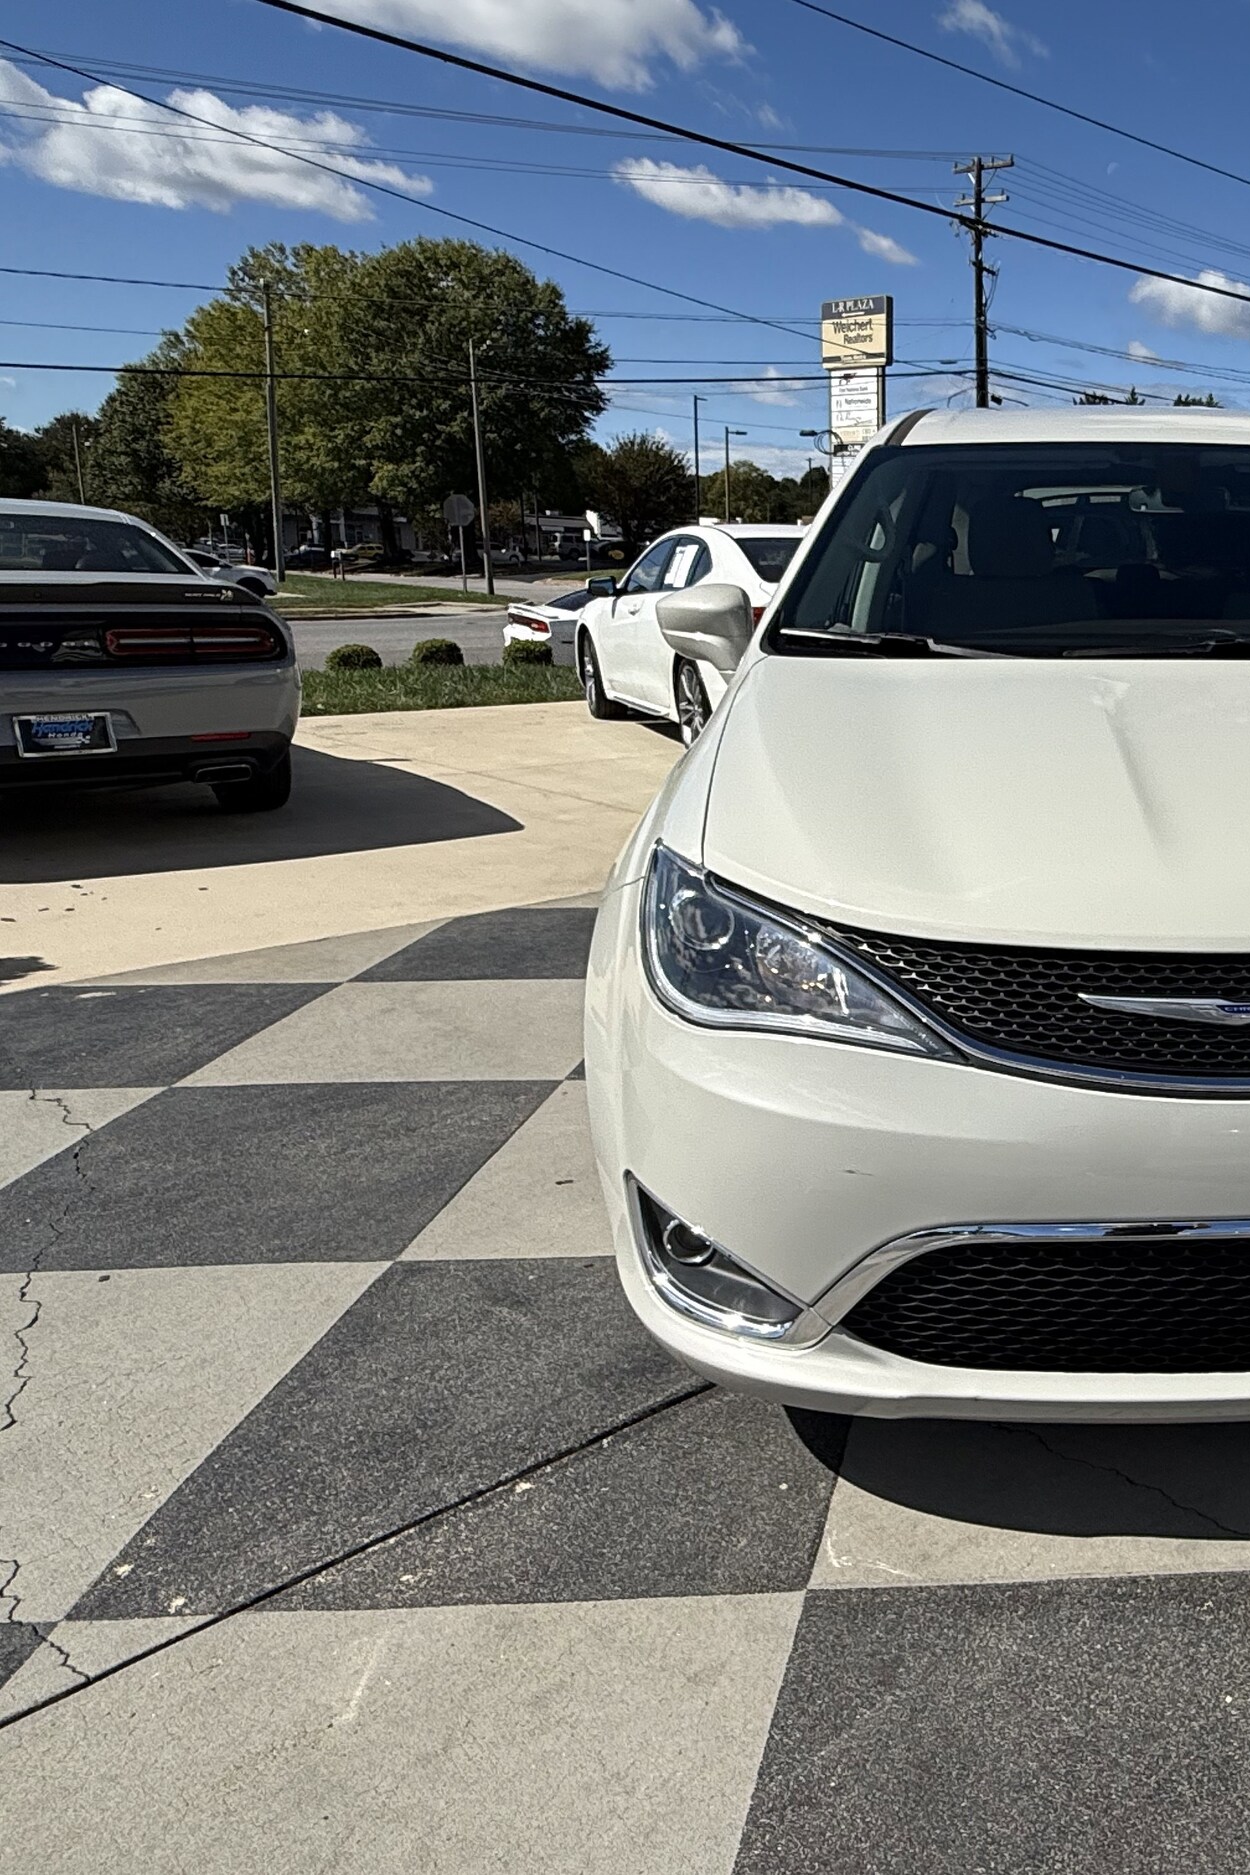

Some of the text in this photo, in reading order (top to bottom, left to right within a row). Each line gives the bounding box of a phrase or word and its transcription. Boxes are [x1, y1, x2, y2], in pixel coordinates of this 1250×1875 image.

[846, 299, 874, 311] PLAZA
[832, 318, 873, 334] Weichert
[843, 333, 873, 345] Realtors
